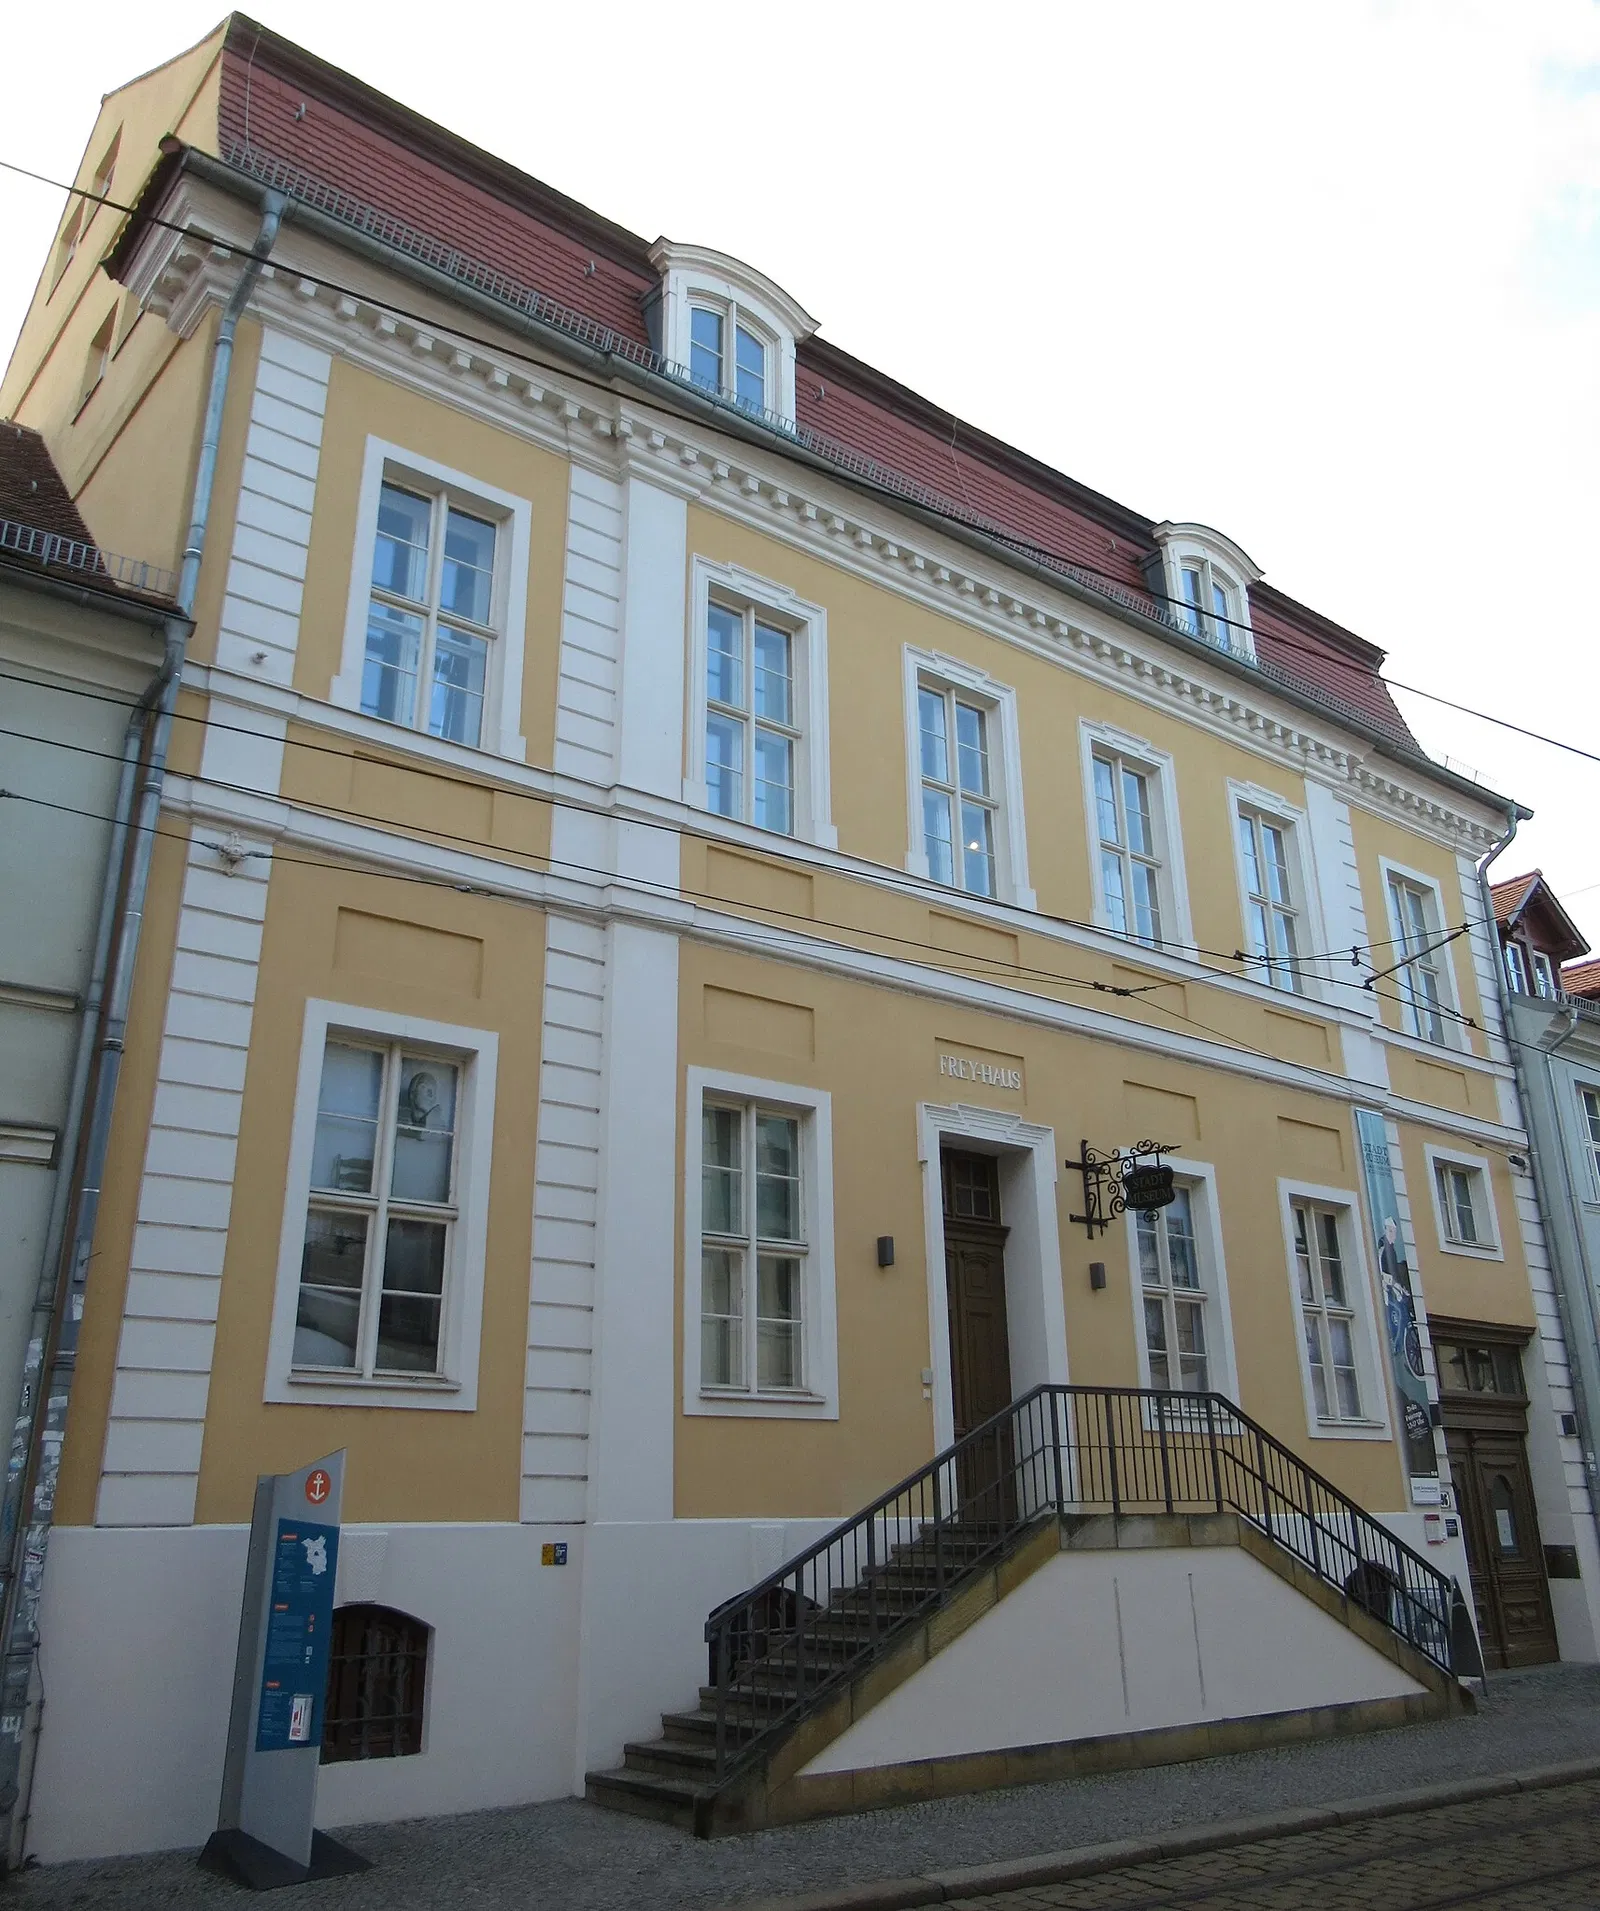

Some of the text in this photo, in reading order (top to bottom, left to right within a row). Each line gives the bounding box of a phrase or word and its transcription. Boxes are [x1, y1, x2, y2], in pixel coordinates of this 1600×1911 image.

[940, 1054, 1021, 1090] FREY-HAUS
[1363, 1142, 1388, 1156] STADT
[1132, 1172, 1165, 1188] STADT
[1129, 1188, 1171, 1204] MUSEUM
